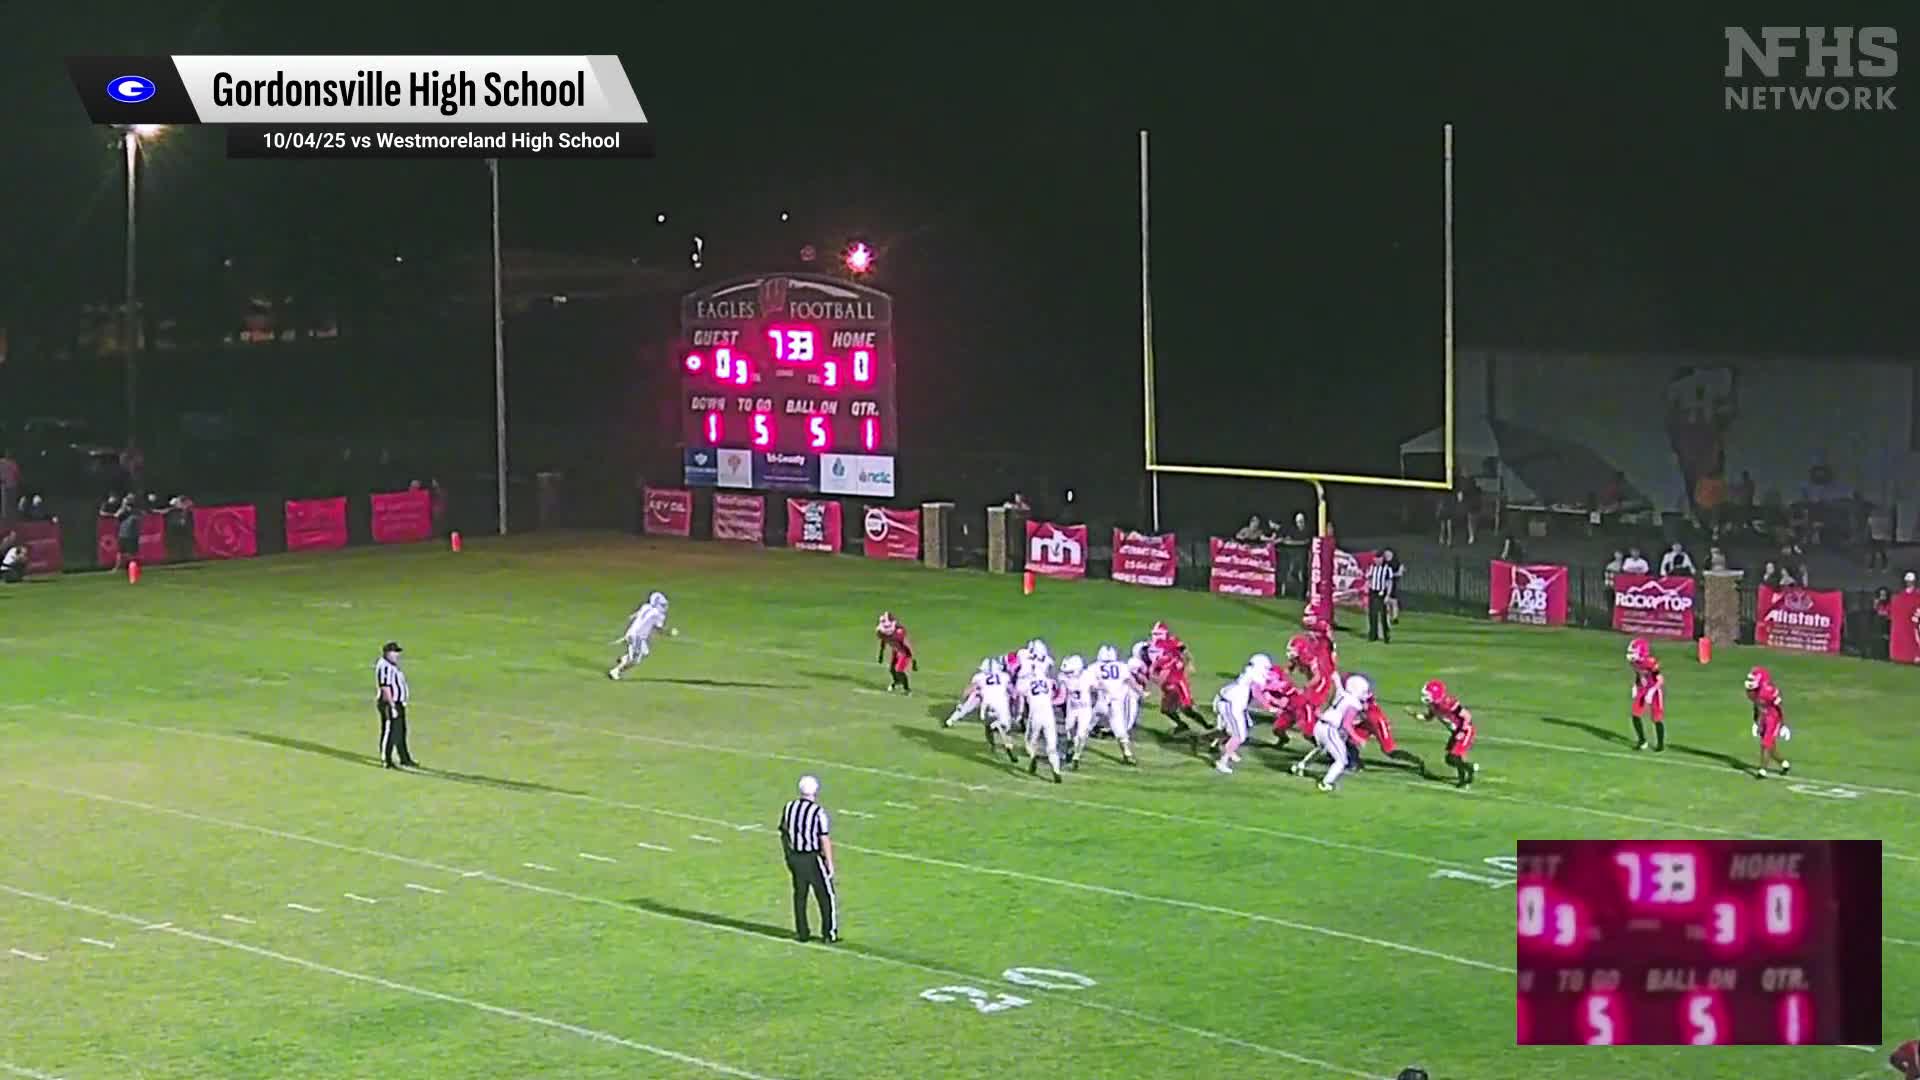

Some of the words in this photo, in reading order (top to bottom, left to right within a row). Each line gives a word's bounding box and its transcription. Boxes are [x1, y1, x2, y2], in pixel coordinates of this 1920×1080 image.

[697, 301, 755, 319] EAGLES
[789, 301, 874, 320] FOOTBALL
[693, 330, 739, 346] GUEST
[832, 331, 876, 348] HOME
[715, 349, 731, 379] 0
[735, 360, 748, 385] 3
[823, 361, 836, 386] 3
[853, 350, 869, 382] 0
[691, 397, 725, 411] DOWN
[737, 398, 752, 411] TO
[755, 398, 772, 411] GO
[786, 400, 815, 414] BALL
[820, 401, 838, 415] ON
[708, 413, 718, 442] 1
[754, 415, 769, 445] 5
[810, 417, 826, 447] 5
[866, 418, 874, 449] 1
[1509, 588, 1547, 610] A&B
[1764, 609, 1830, 628] Allstate
[985, 673, 1001, 686] 21
[1100, 664, 1120, 680] 50
